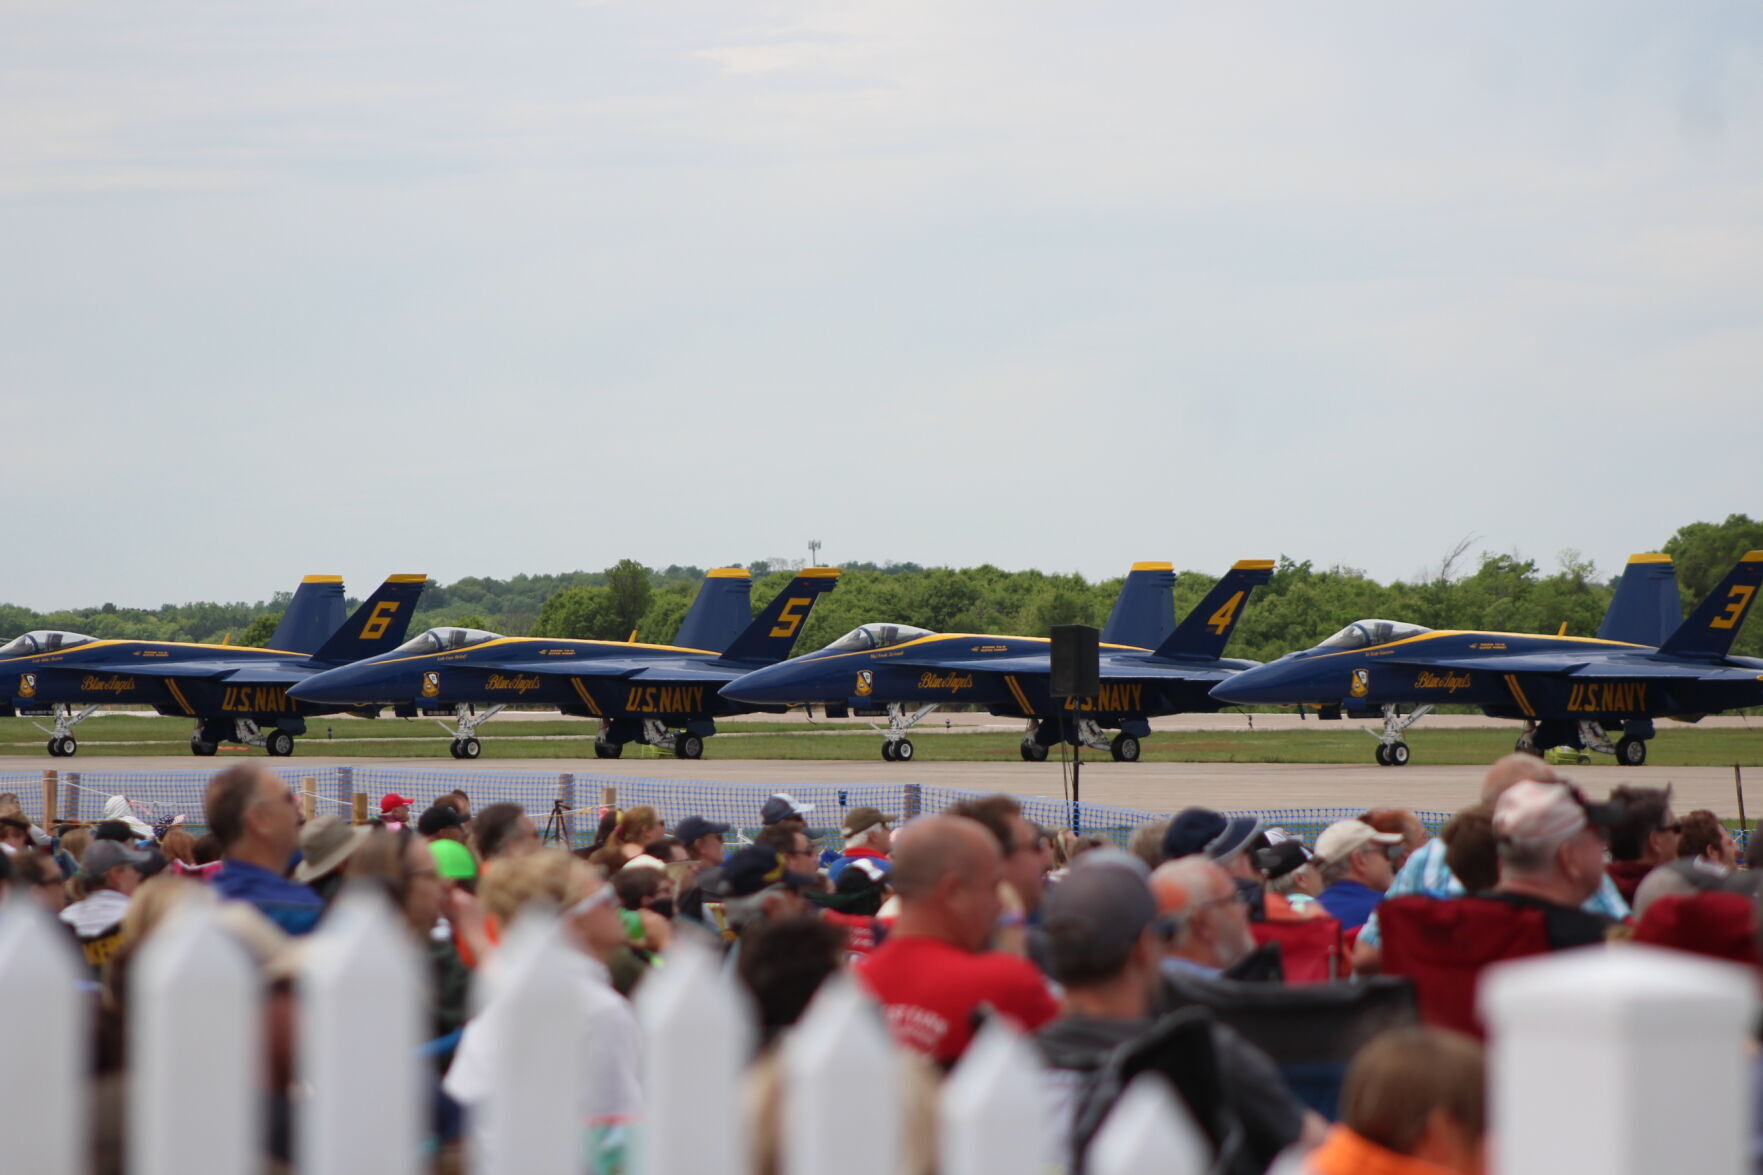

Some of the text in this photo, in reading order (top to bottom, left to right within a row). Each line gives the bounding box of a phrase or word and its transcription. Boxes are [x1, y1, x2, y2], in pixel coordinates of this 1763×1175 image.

[358, 601, 400, 640] 6
[768, 597, 812, 638] 5
[1207, 590, 1246, 636] 4
[1709, 585, 1756, 630] 3
[81, 674, 136, 695] Blue Angels
[485, 673, 541, 695] Blue Angels
[918, 671, 974, 694] Blue Angels
[1414, 670, 1471, 694] Blue Angels
